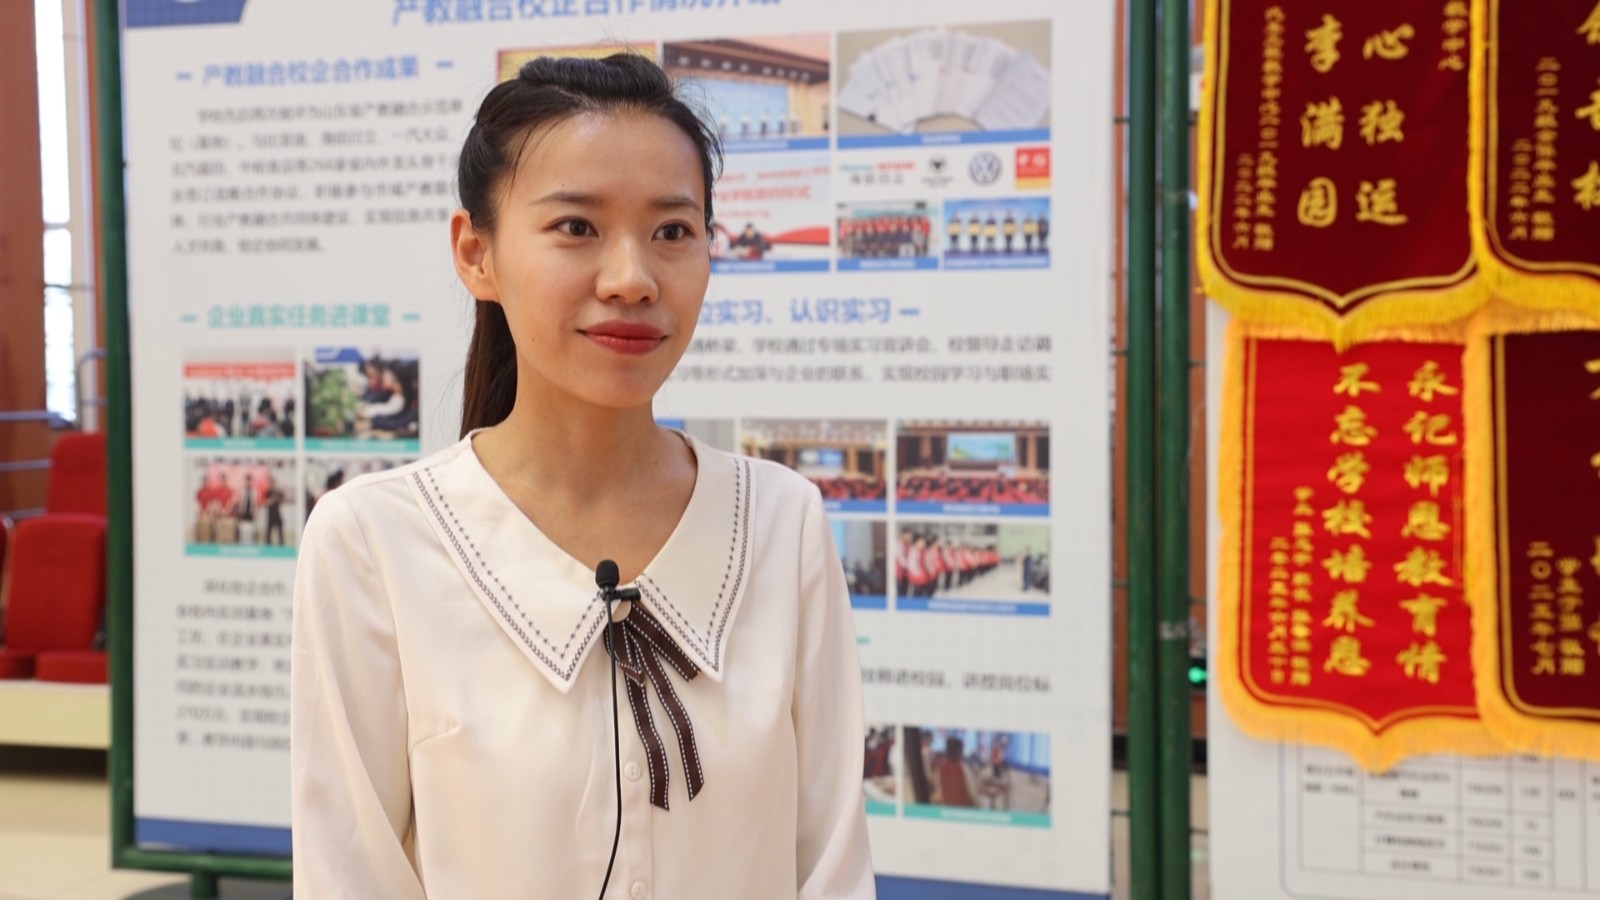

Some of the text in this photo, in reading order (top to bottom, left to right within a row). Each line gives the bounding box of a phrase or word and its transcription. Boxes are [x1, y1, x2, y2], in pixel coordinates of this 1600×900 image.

[202, 56, 419, 87] 产教融合校企合作成果
[1355, 24, 1415, 226] 心独运
[208, 303, 390, 328] 企业真实任务进课堂
[1320, 362, 1382, 678] 不忘学校培养恩
[1394, 359, 1459, 685] 永记师恩教育情
